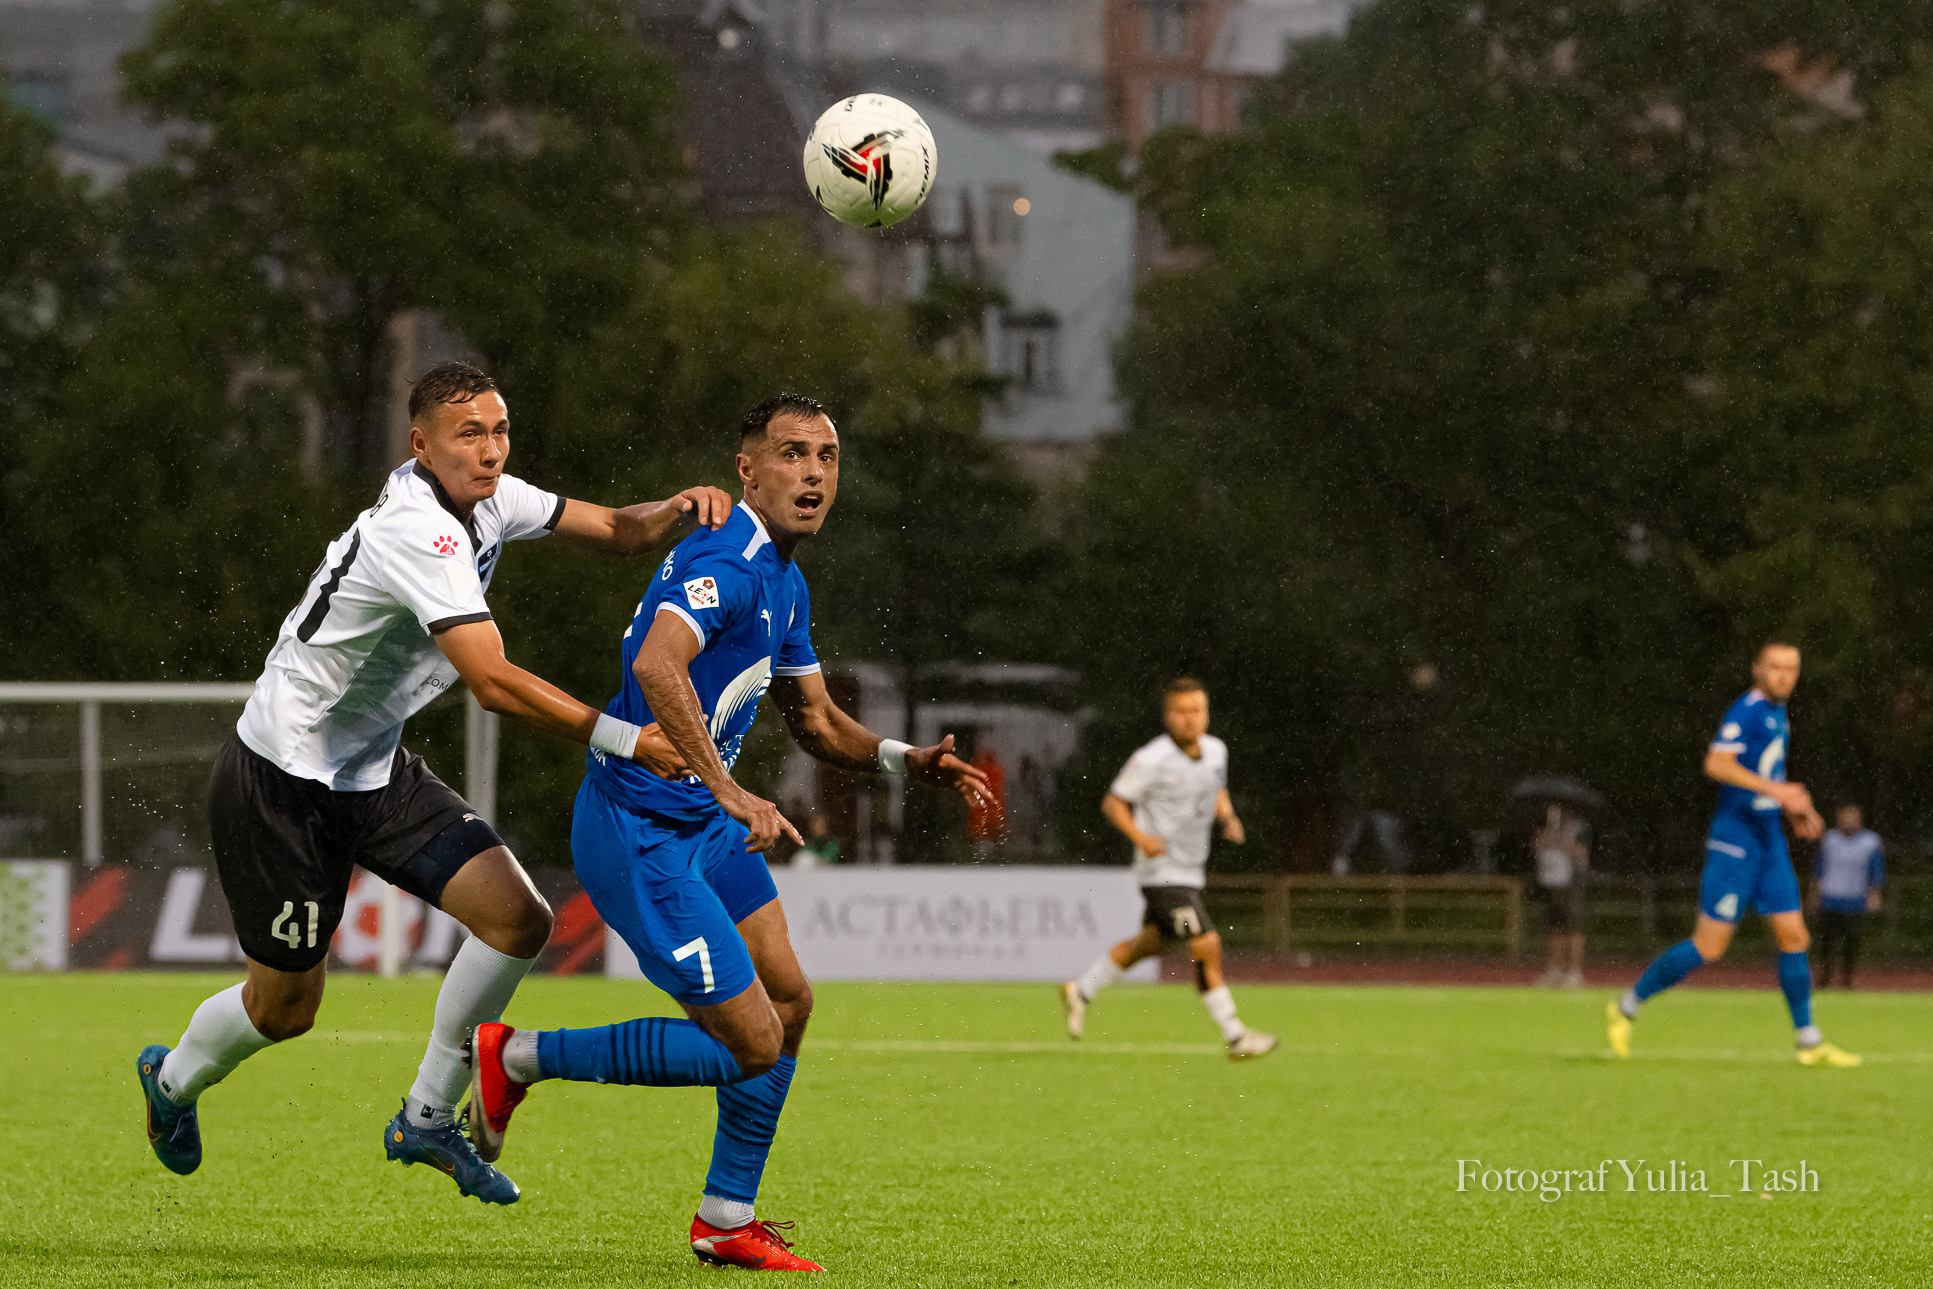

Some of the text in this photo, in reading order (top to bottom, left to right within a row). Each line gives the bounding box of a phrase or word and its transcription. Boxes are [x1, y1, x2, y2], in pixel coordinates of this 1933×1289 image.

[271, 900, 319, 949] 41
[803, 895, 1099, 939] АСТАФЬЕВА
[672, 936, 715, 993] 7
